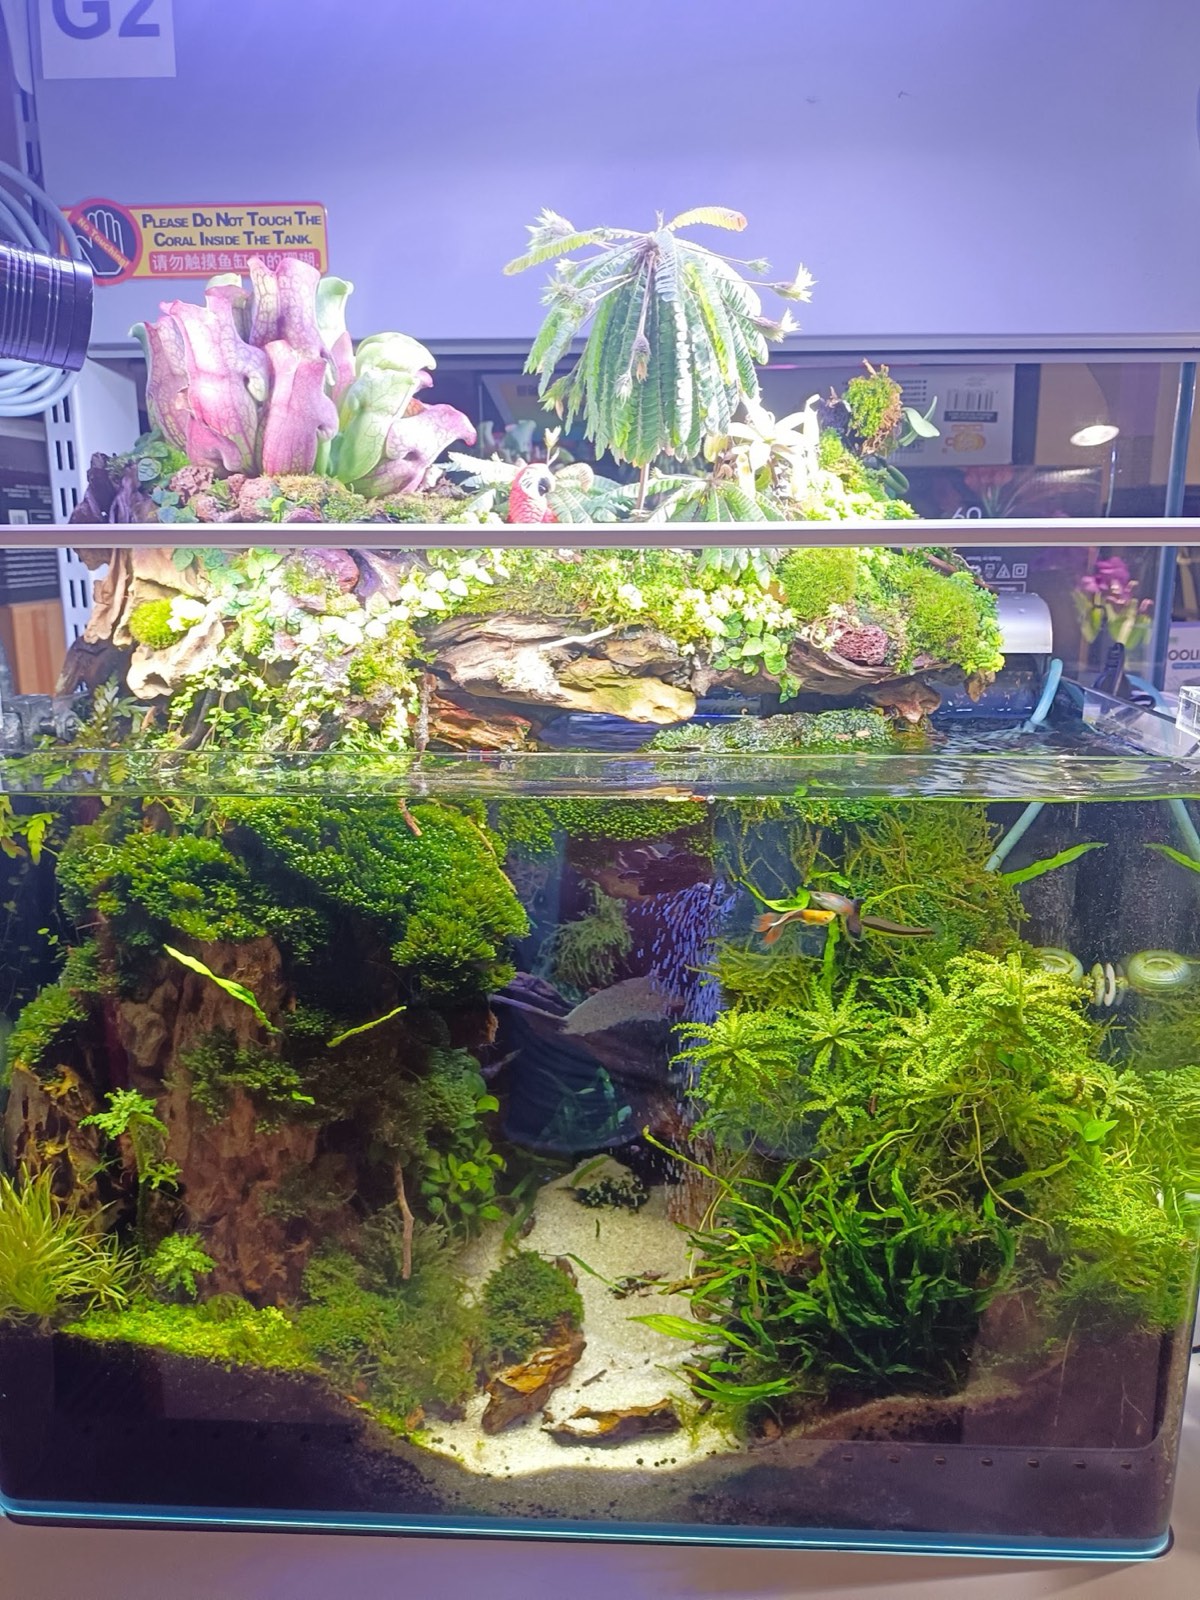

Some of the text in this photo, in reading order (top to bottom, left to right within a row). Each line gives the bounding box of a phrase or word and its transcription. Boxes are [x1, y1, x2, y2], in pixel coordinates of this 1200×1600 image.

[142, 210, 322, 229] PLEASE DO NOT TOUCH THE
[153, 231, 196, 247] CORAL
[199, 230, 241, 246] INSIDE
[243, 230, 270, 245] THE
